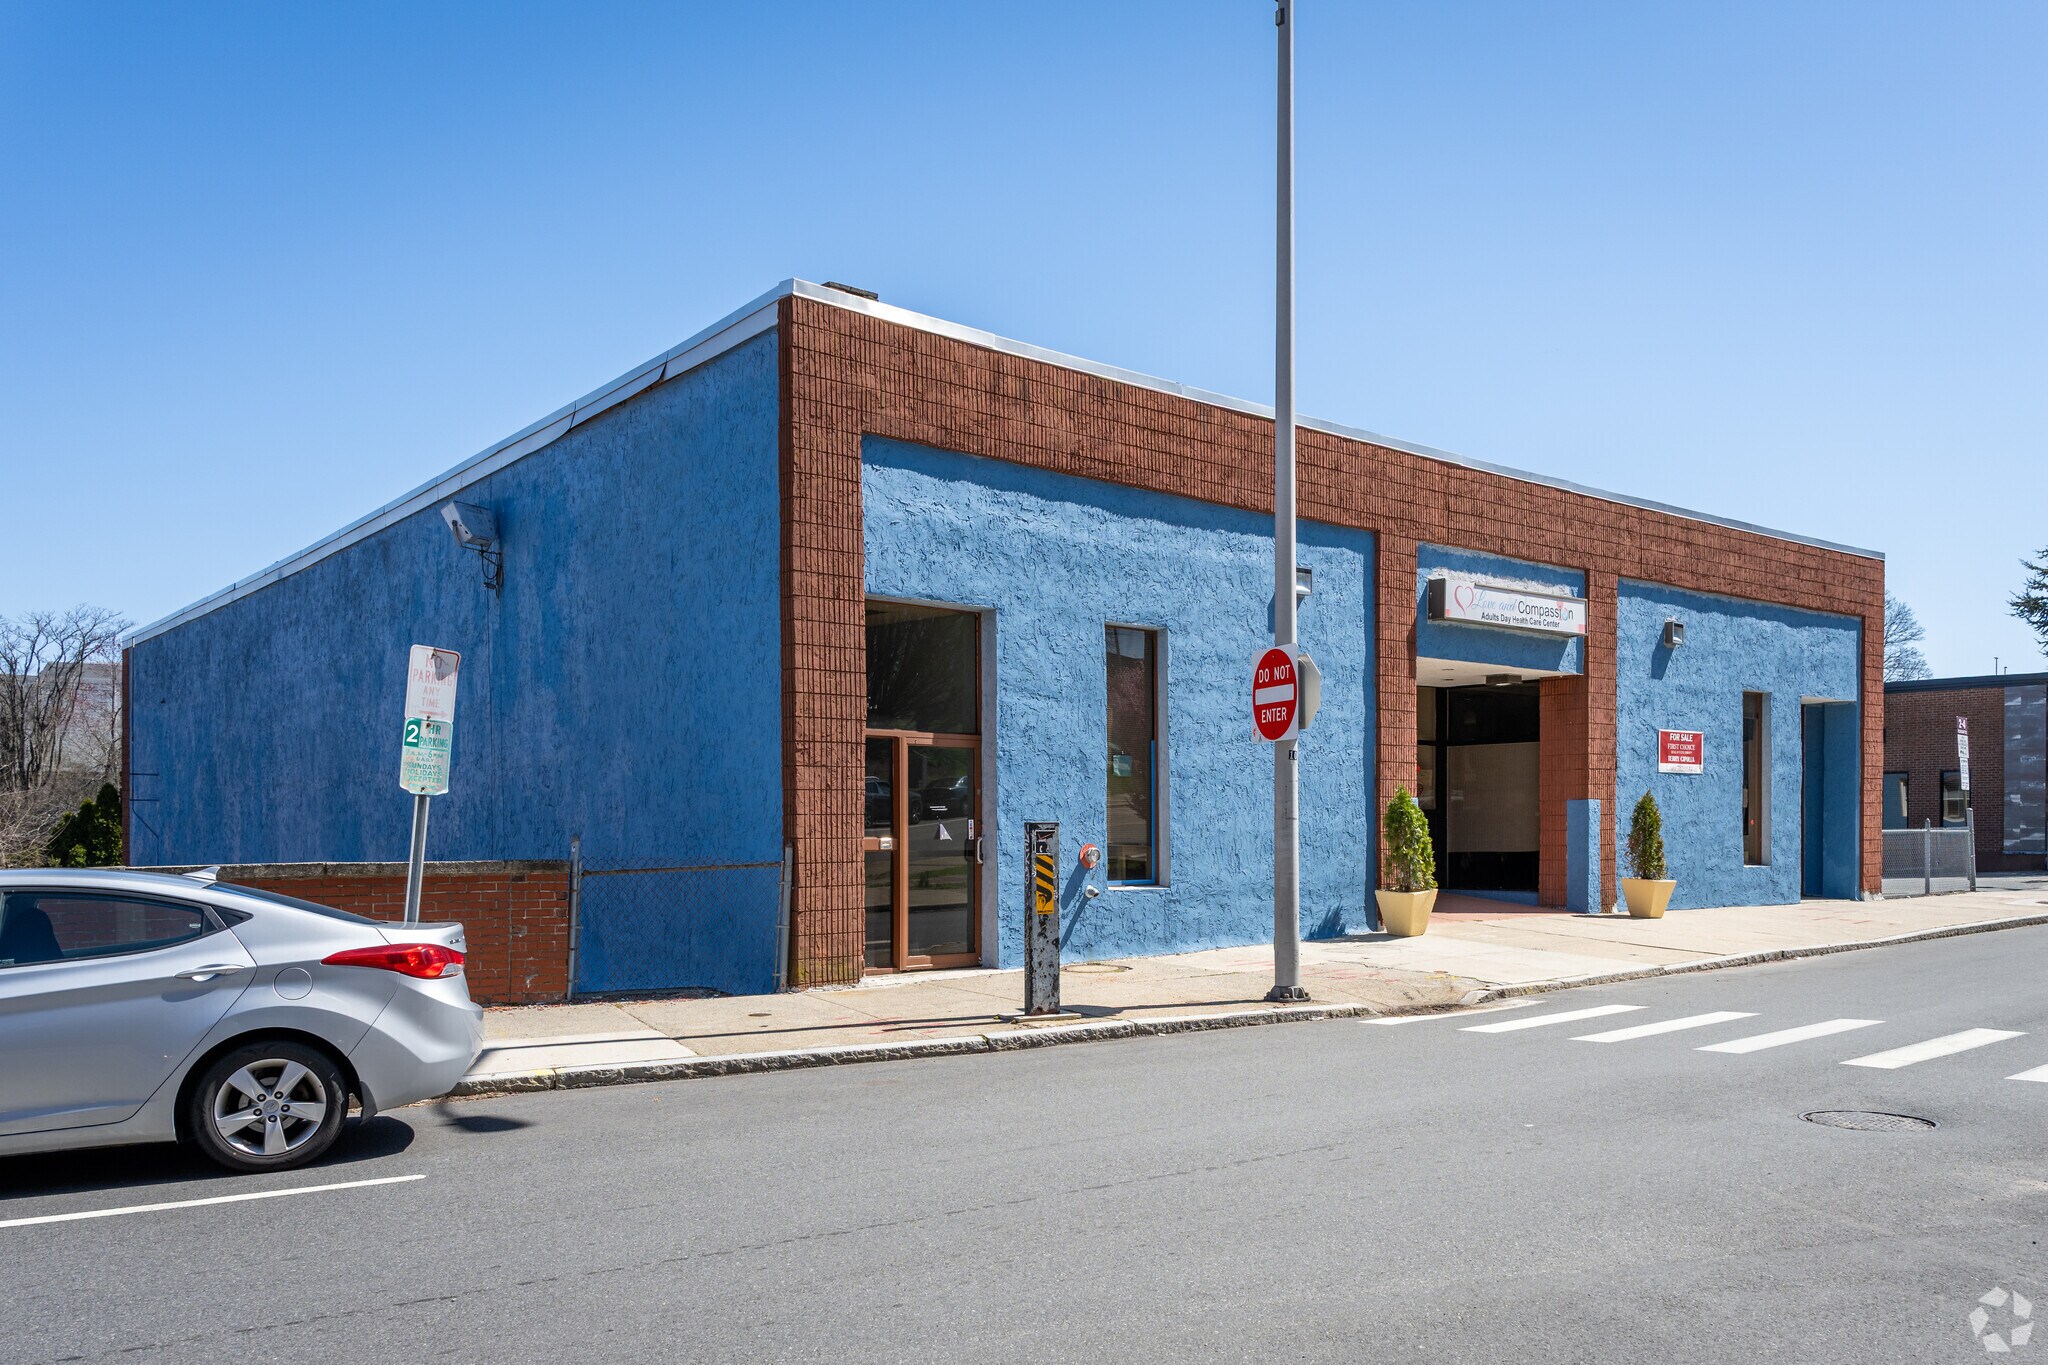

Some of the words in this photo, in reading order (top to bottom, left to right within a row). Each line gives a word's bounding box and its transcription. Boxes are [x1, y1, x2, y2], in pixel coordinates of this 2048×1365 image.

[1471, 590, 1495, 610] Love
[1499, 599, 1517, 612] and
[1517, 600, 1574, 620] Compassion
[1481, 612, 1500, 622] Adults
[1500, 614, 1512, 624] Day
[1512, 615, 1528, 625] Health
[1529, 617, 1542, 626] Care
[1542, 619, 1560, 628] Center
[425, 653, 443, 670] NO
[412, 668, 453, 687] PARKING
[1258, 668, 1270, 684] DO
[1274, 664, 1290, 681] NOT
[423, 685, 440, 697] ANY
[421, 697, 440, 709] TIME
[1261, 707, 1287, 724] ENTER
[406, 724, 419, 743] 2
[428, 724, 441, 735] HR
[1669, 733, 1680, 741] FOR
[1680, 733, 1693, 742] SALE
[420, 735, 449, 749] PARKING
[407, 761, 442, 772] SUNDAYS
[404, 774, 442, 784] XCEPTED
